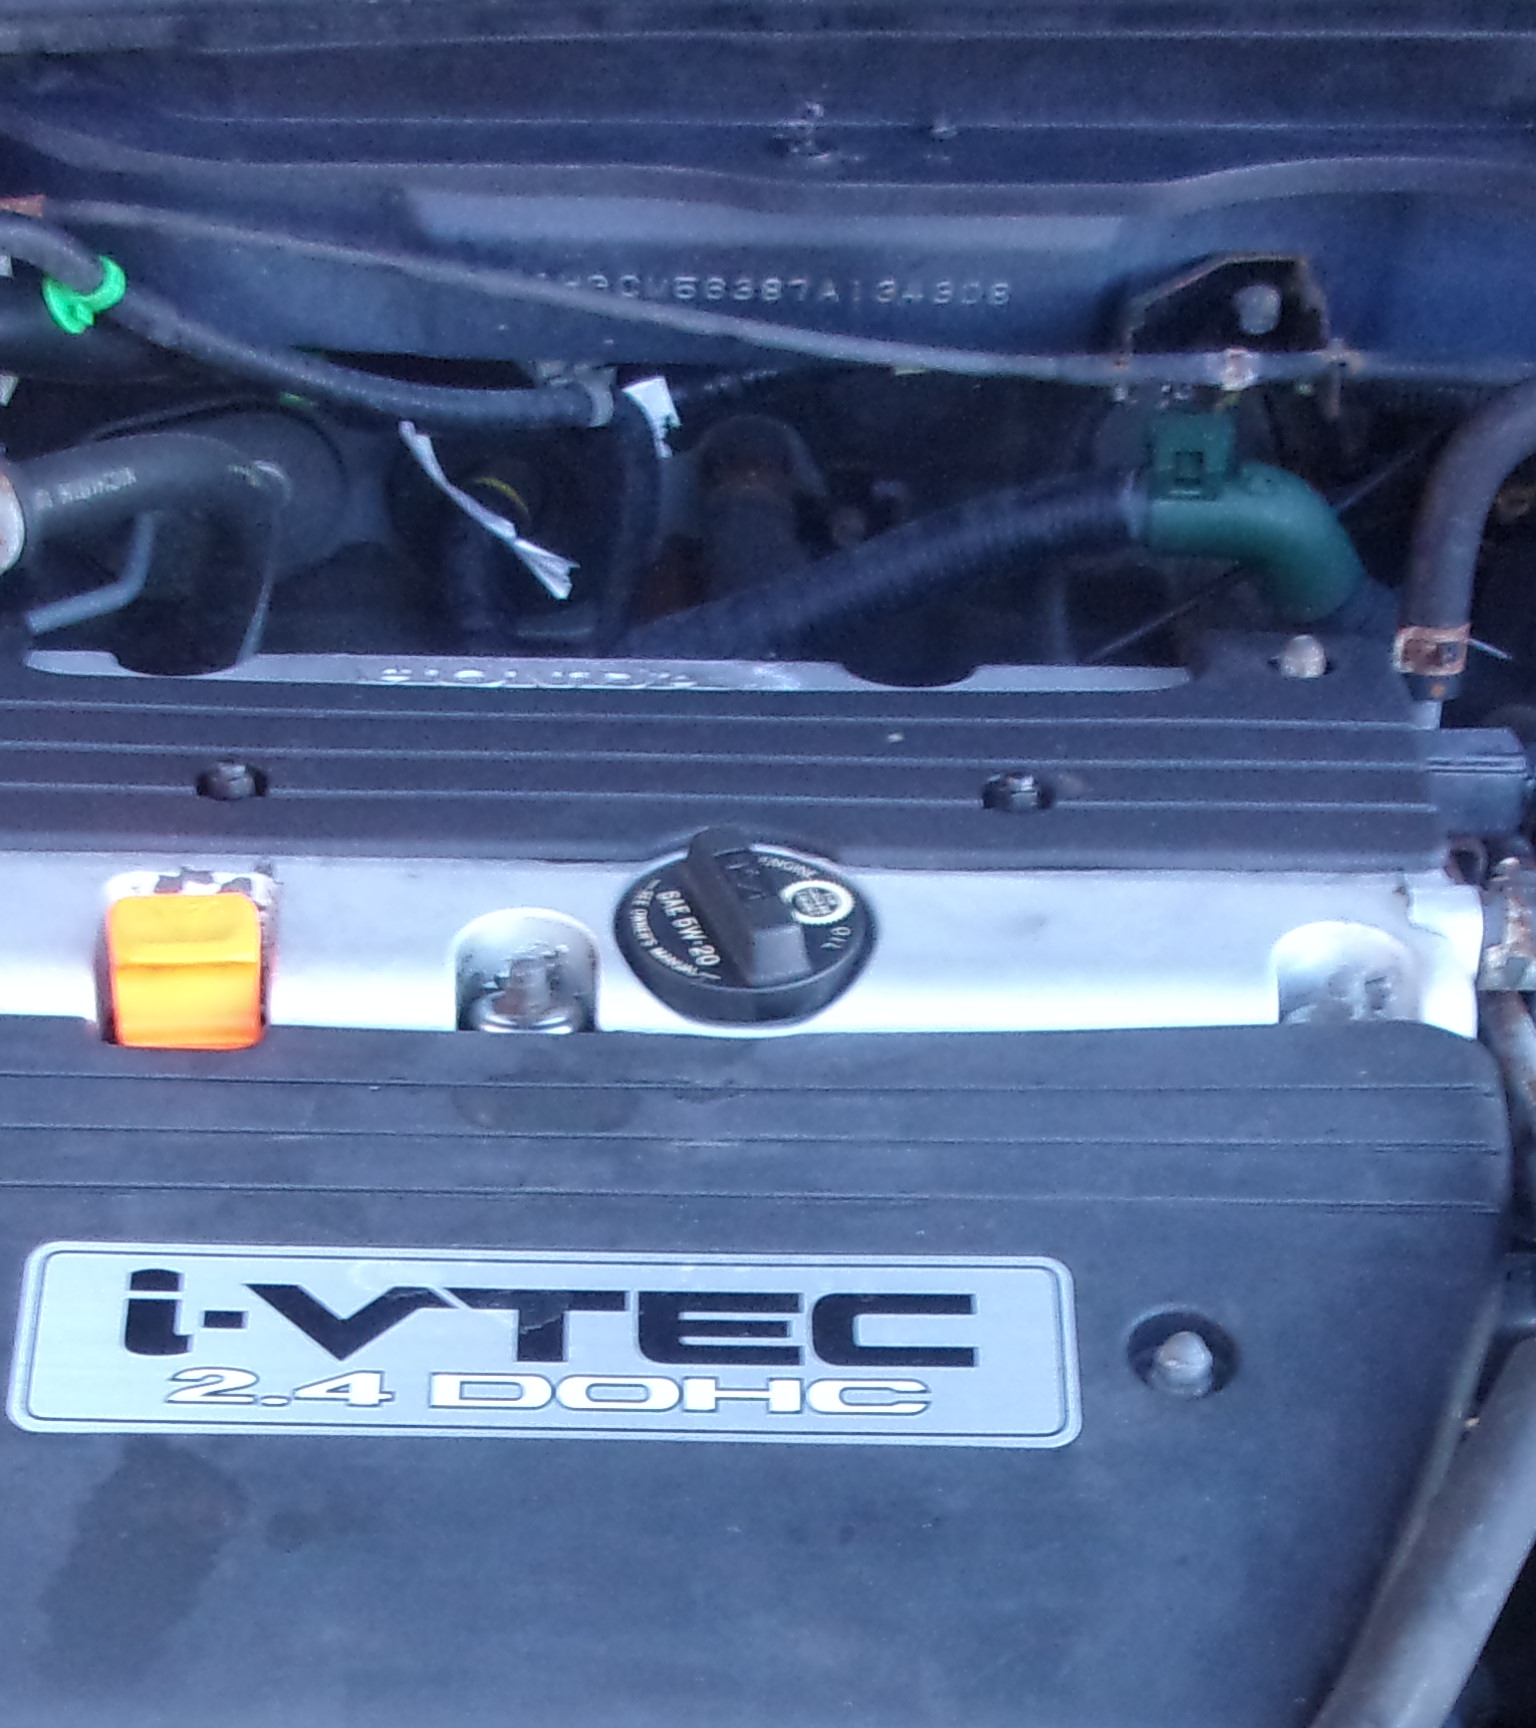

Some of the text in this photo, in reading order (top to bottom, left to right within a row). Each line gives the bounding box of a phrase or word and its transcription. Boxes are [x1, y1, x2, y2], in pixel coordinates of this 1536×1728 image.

[124, 1267, 977, 1368] i-VTEC
[164, 1367, 931, 1416] 2.4 DOHC
